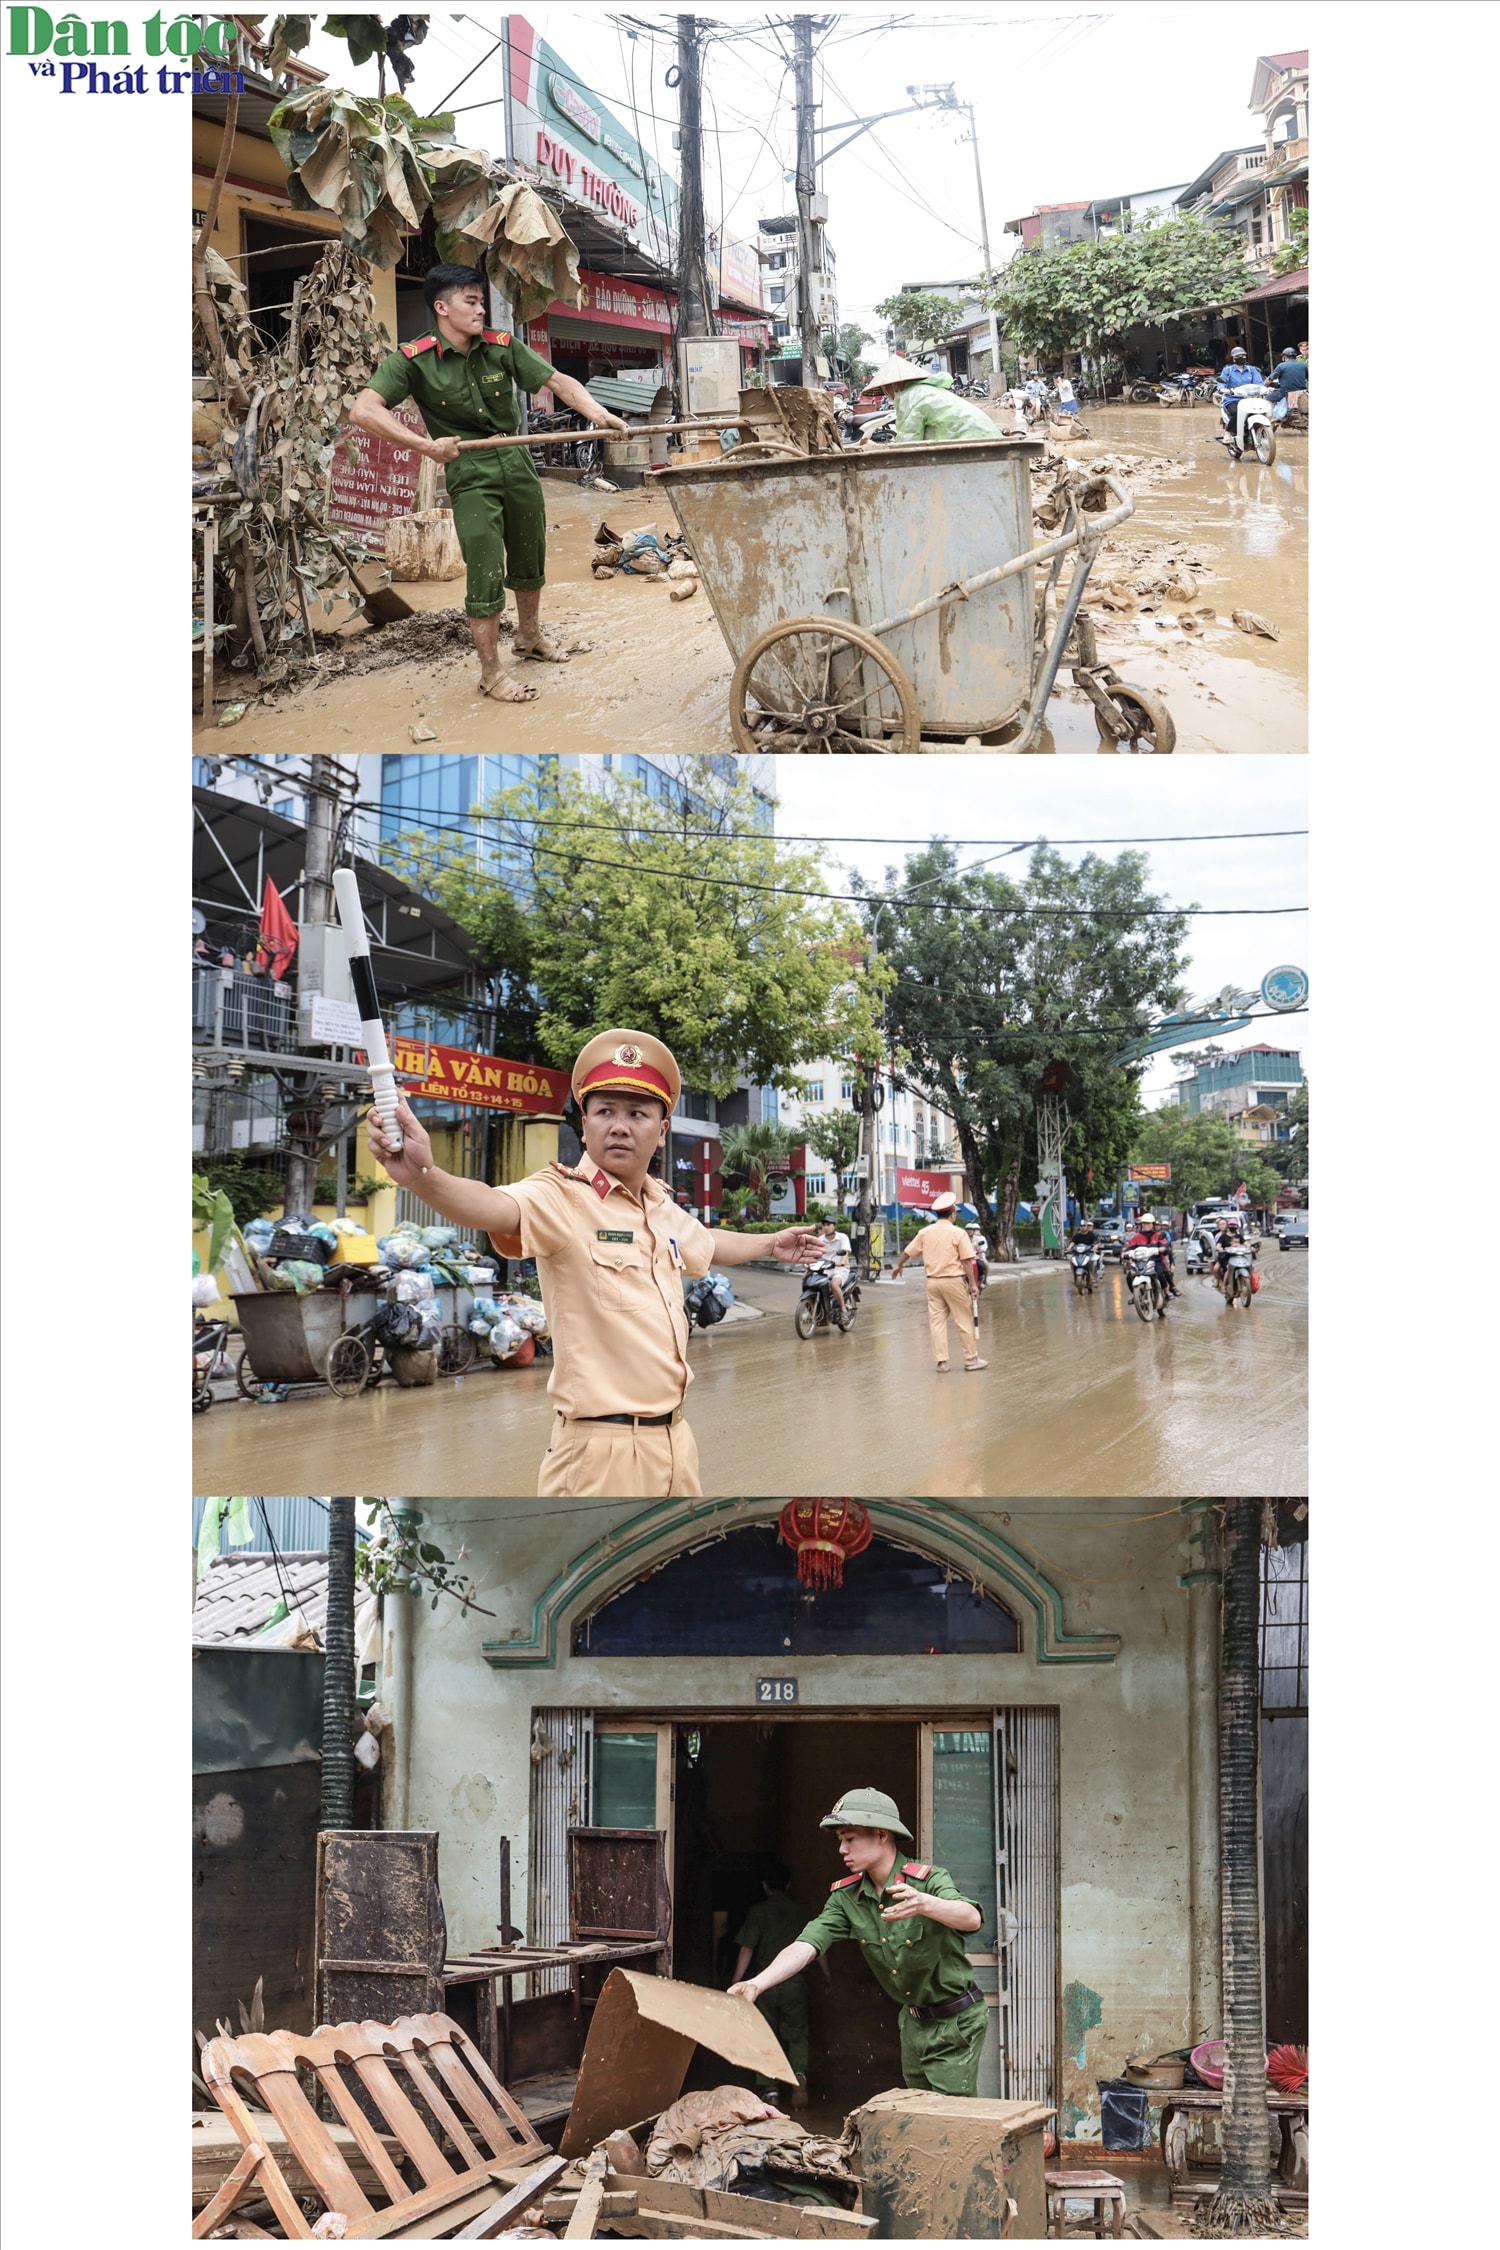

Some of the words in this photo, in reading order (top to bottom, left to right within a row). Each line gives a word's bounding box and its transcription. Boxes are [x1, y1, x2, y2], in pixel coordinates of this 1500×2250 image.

[537, 131, 577, 184] DUY
[581, 166, 637, 228] THƯỜNG
[595, 280, 611, 312] BẢO
[613, 288, 637, 318] DƯỠNG
[642, 292, 656, 321] SỬA
[357, 467, 376, 481] NẤU
[356, 481, 375, 494] LÀM
[379, 484, 416, 499] NGUYÊN
[393, 1048, 446, 1078] NHÀ
[449, 1056, 502, 1089] VĂN
[507, 1069, 554, 1098] HÓA
[421, 1081, 449, 1097] LIÊN
[451, 1083, 468, 1099] TỔ
[470, 1090, 523, 1108] 13+14+15
[760, 1683, 794, 1701] 218
